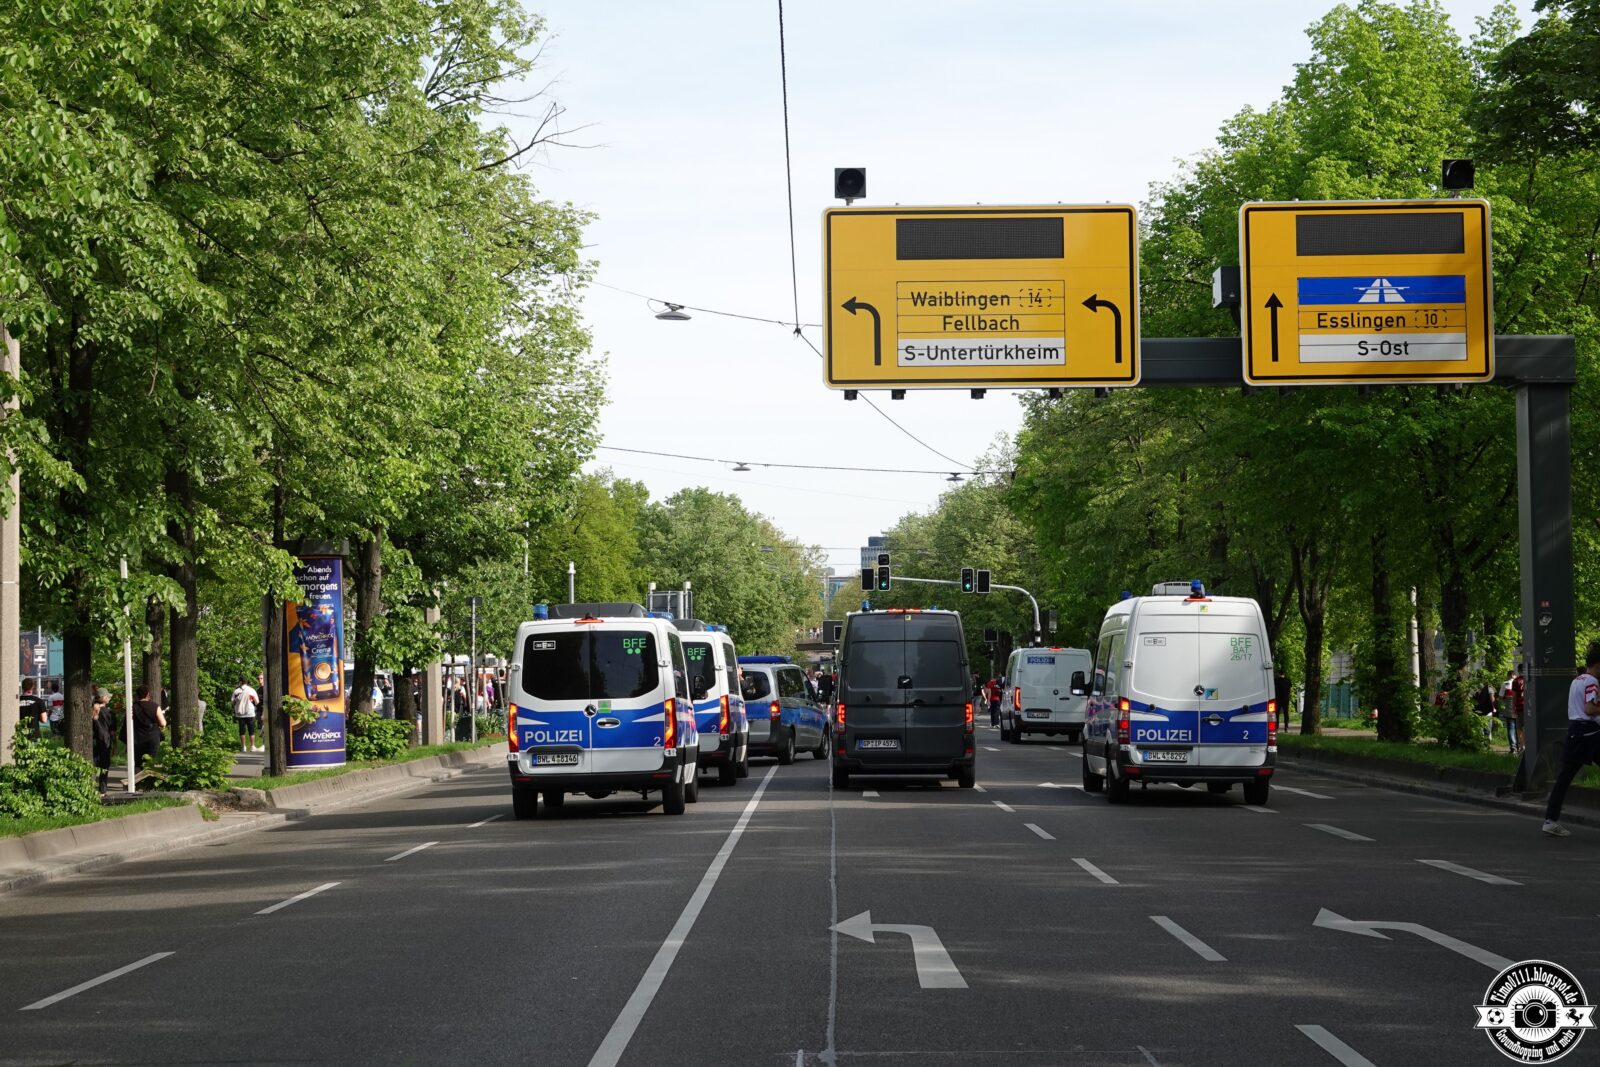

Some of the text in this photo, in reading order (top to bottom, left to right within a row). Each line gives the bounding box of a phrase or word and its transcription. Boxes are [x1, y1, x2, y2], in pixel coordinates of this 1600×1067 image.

[910, 291, 1043, 310] Waiblingen 14
[942, 315, 1020, 331] Fellbach
[1317, 312, 1438, 331] Esslingen 10
[904, 344, 1060, 362] S-Untertürkheim
[1357, 340, 1410, 356] S-Ost
[307, 565, 332, 573] Abends
[622, 638, 647, 649] BFE
[1230, 637, 1252, 647] BFE
[687, 647, 706, 656] BFE
[1232, 646, 1250, 654] BAT
[1230, 653, 1252, 661] 26/17
[711, 724, 717, 733] 2
[303, 731, 341, 740] MÖVENPICK
[524, 729, 583, 744] POLIZEI
[1136, 729, 1192, 742] POLIZEI
[1242, 730, 1249, 740] 2
[653, 736, 661, 747] 2
